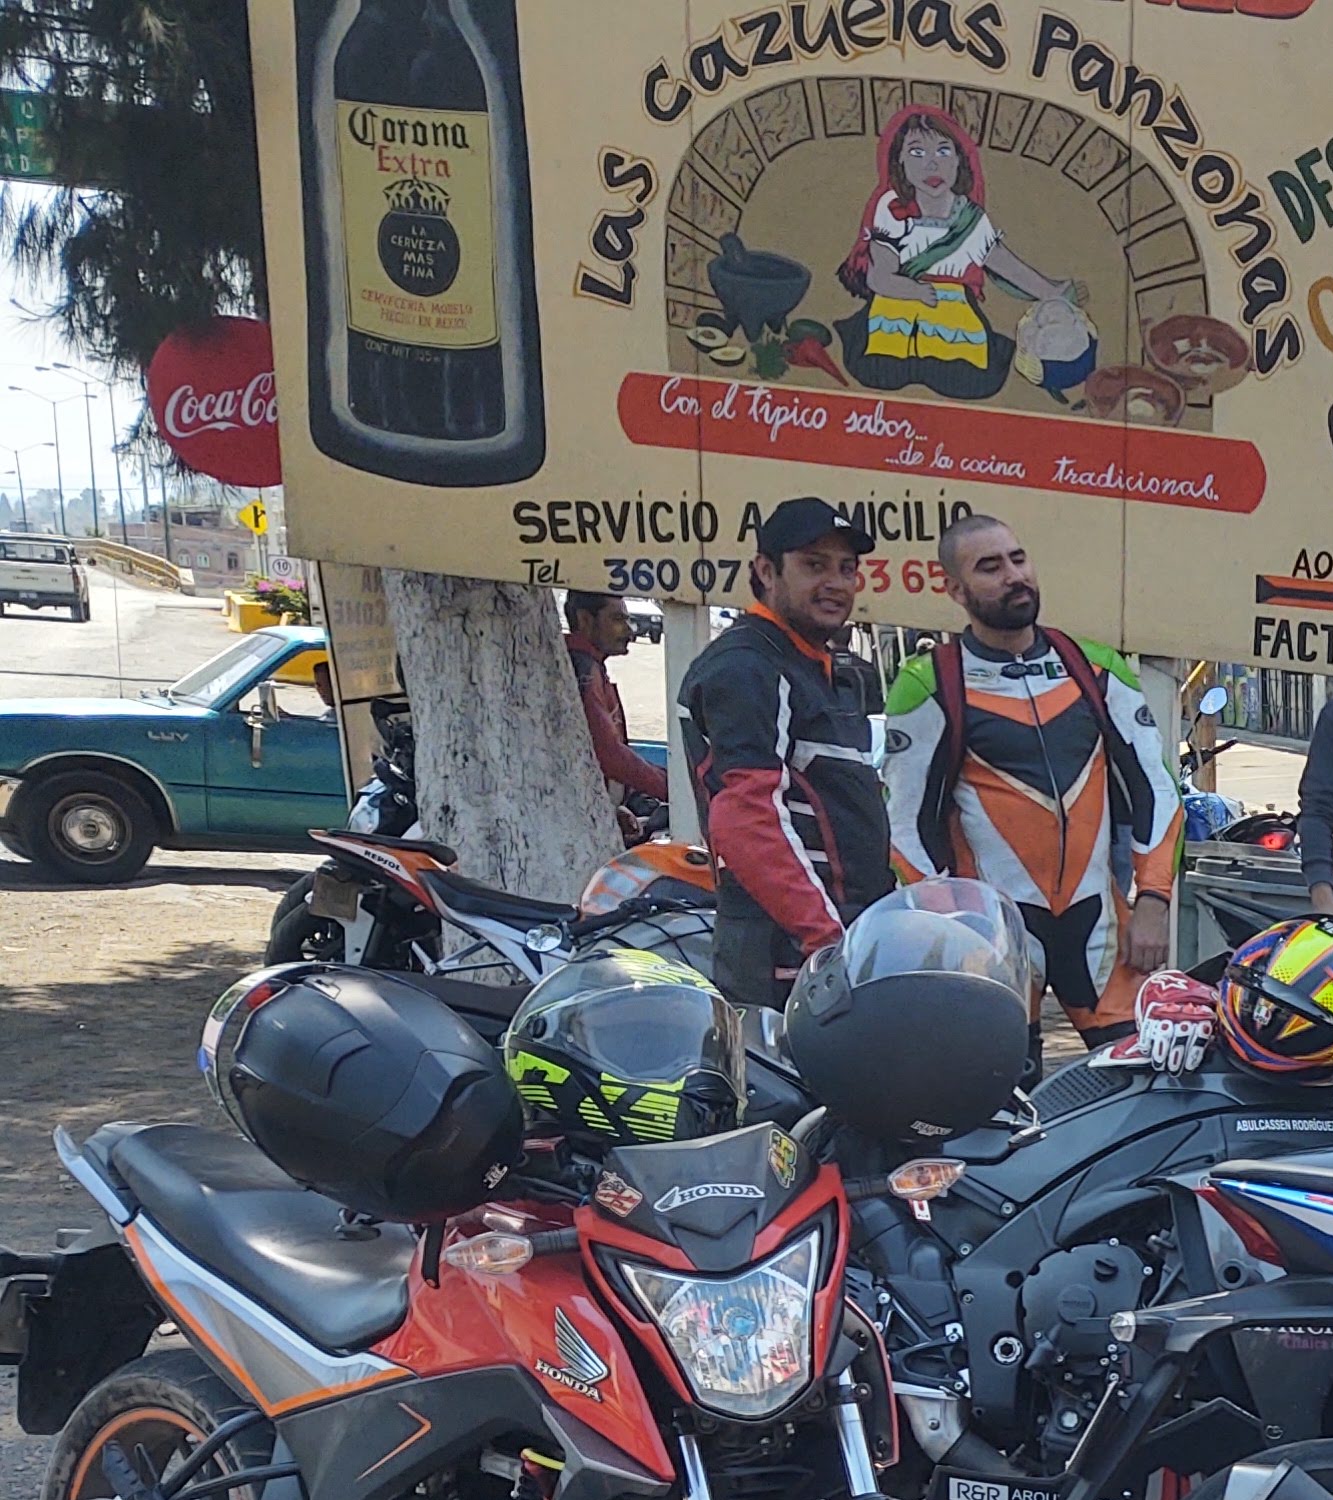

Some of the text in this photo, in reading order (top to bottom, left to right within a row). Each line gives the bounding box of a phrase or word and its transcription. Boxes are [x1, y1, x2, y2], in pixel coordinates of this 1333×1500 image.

[349, 106, 469, 150] Corona
[377, 145, 451, 178] Extra
[581, 0, 1299, 375] Las Cazuelas Panzonas
[391, 235, 446, 251] CERVEZA
[411, 225, 427, 236] LA
[403, 252, 434, 265] MAS
[403, 267, 435, 279] FINA
[165, 371, 278, 438] Coca-Co
[660, 377, 701, 415] Con
[712, 380, 739, 420] el
[931, 443, 953, 469] la
[960, 455, 1026, 479] cocina
[513, 491, 718, 544] SERVICIO
[737, 503, 762, 543] A
[276, 559, 289, 572] 10
[603, 558, 681, 593] 360
[690, 559, 744, 594] 07
[1237, 1120, 1290, 1132] ABULCASSEN
[680, 1184, 760, 1202] HONDA
[534, 1358, 602, 1402] HONDA
